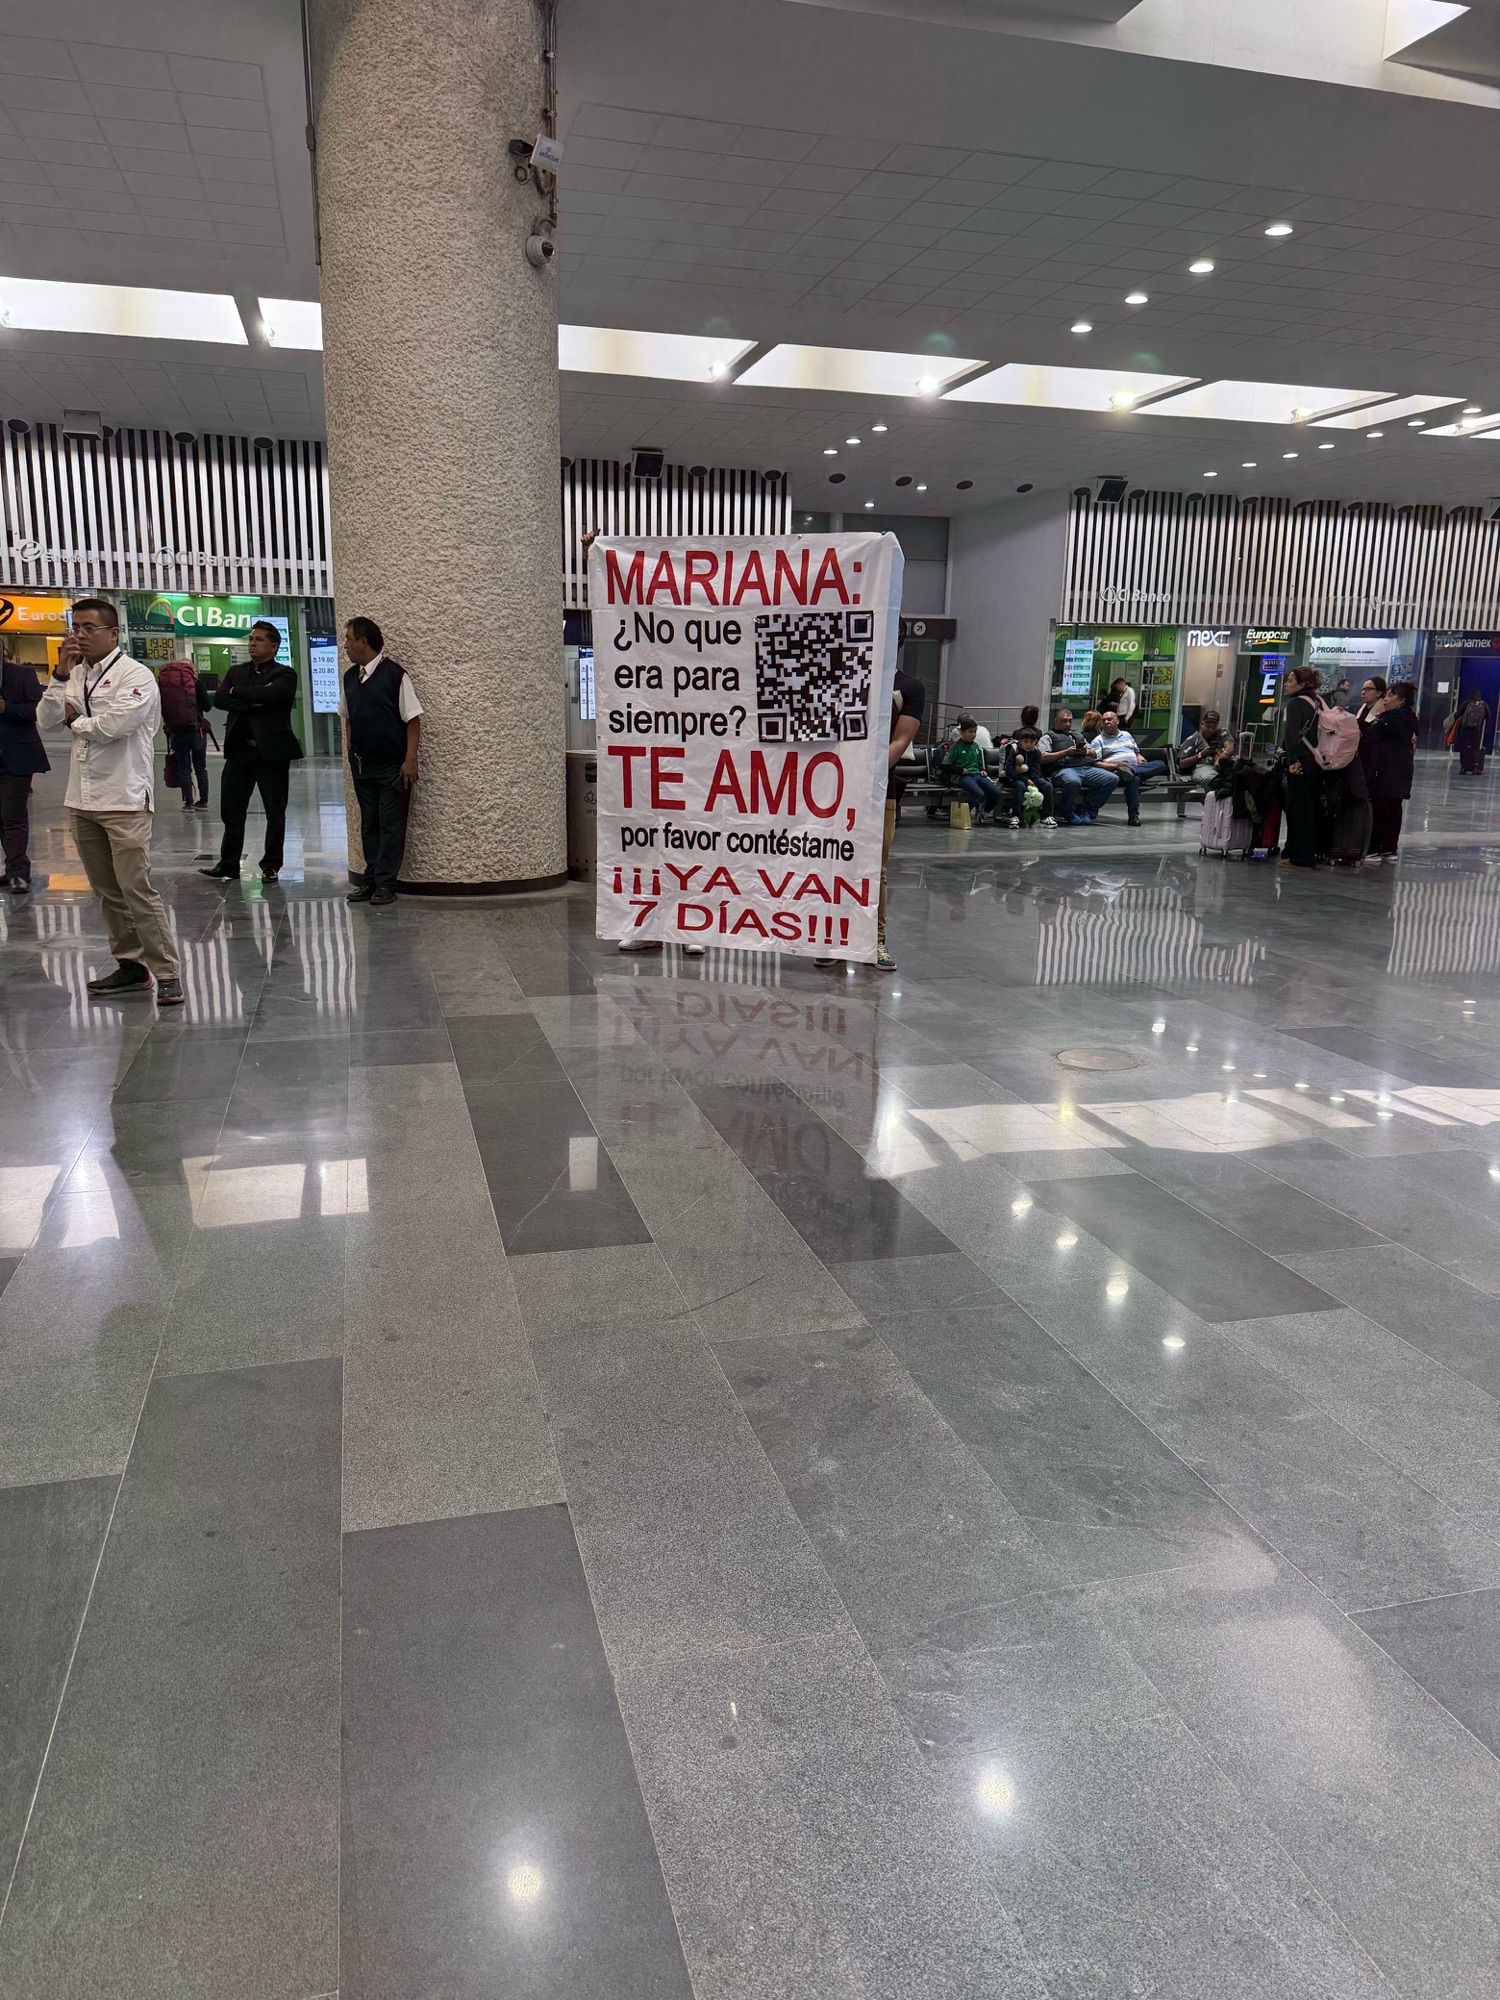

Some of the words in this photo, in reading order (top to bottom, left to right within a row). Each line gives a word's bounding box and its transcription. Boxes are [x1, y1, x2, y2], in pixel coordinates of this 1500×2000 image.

[605, 548, 862, 606] MARIANA:
[613, 611, 675, 652] ¿No
[684, 619, 742, 653] que
[1246, 628, 1291, 642] Europcar
[1316, 646, 1347, 654] PRODIRA
[614, 664, 664, 690] era
[673, 665, 740, 698] para
[608, 702, 747, 743] siempre?
[607, 745, 686, 811] TE
[704, 749, 857, 832] AMO,
[620, 825, 659, 853] por
[662, 821, 721, 852] favor
[726, 828, 855, 862] contéstame
[757, 868, 871, 907] VAN
[628, 899, 658, 928] 7
[676, 899, 850, 947] DÍAS!!!
